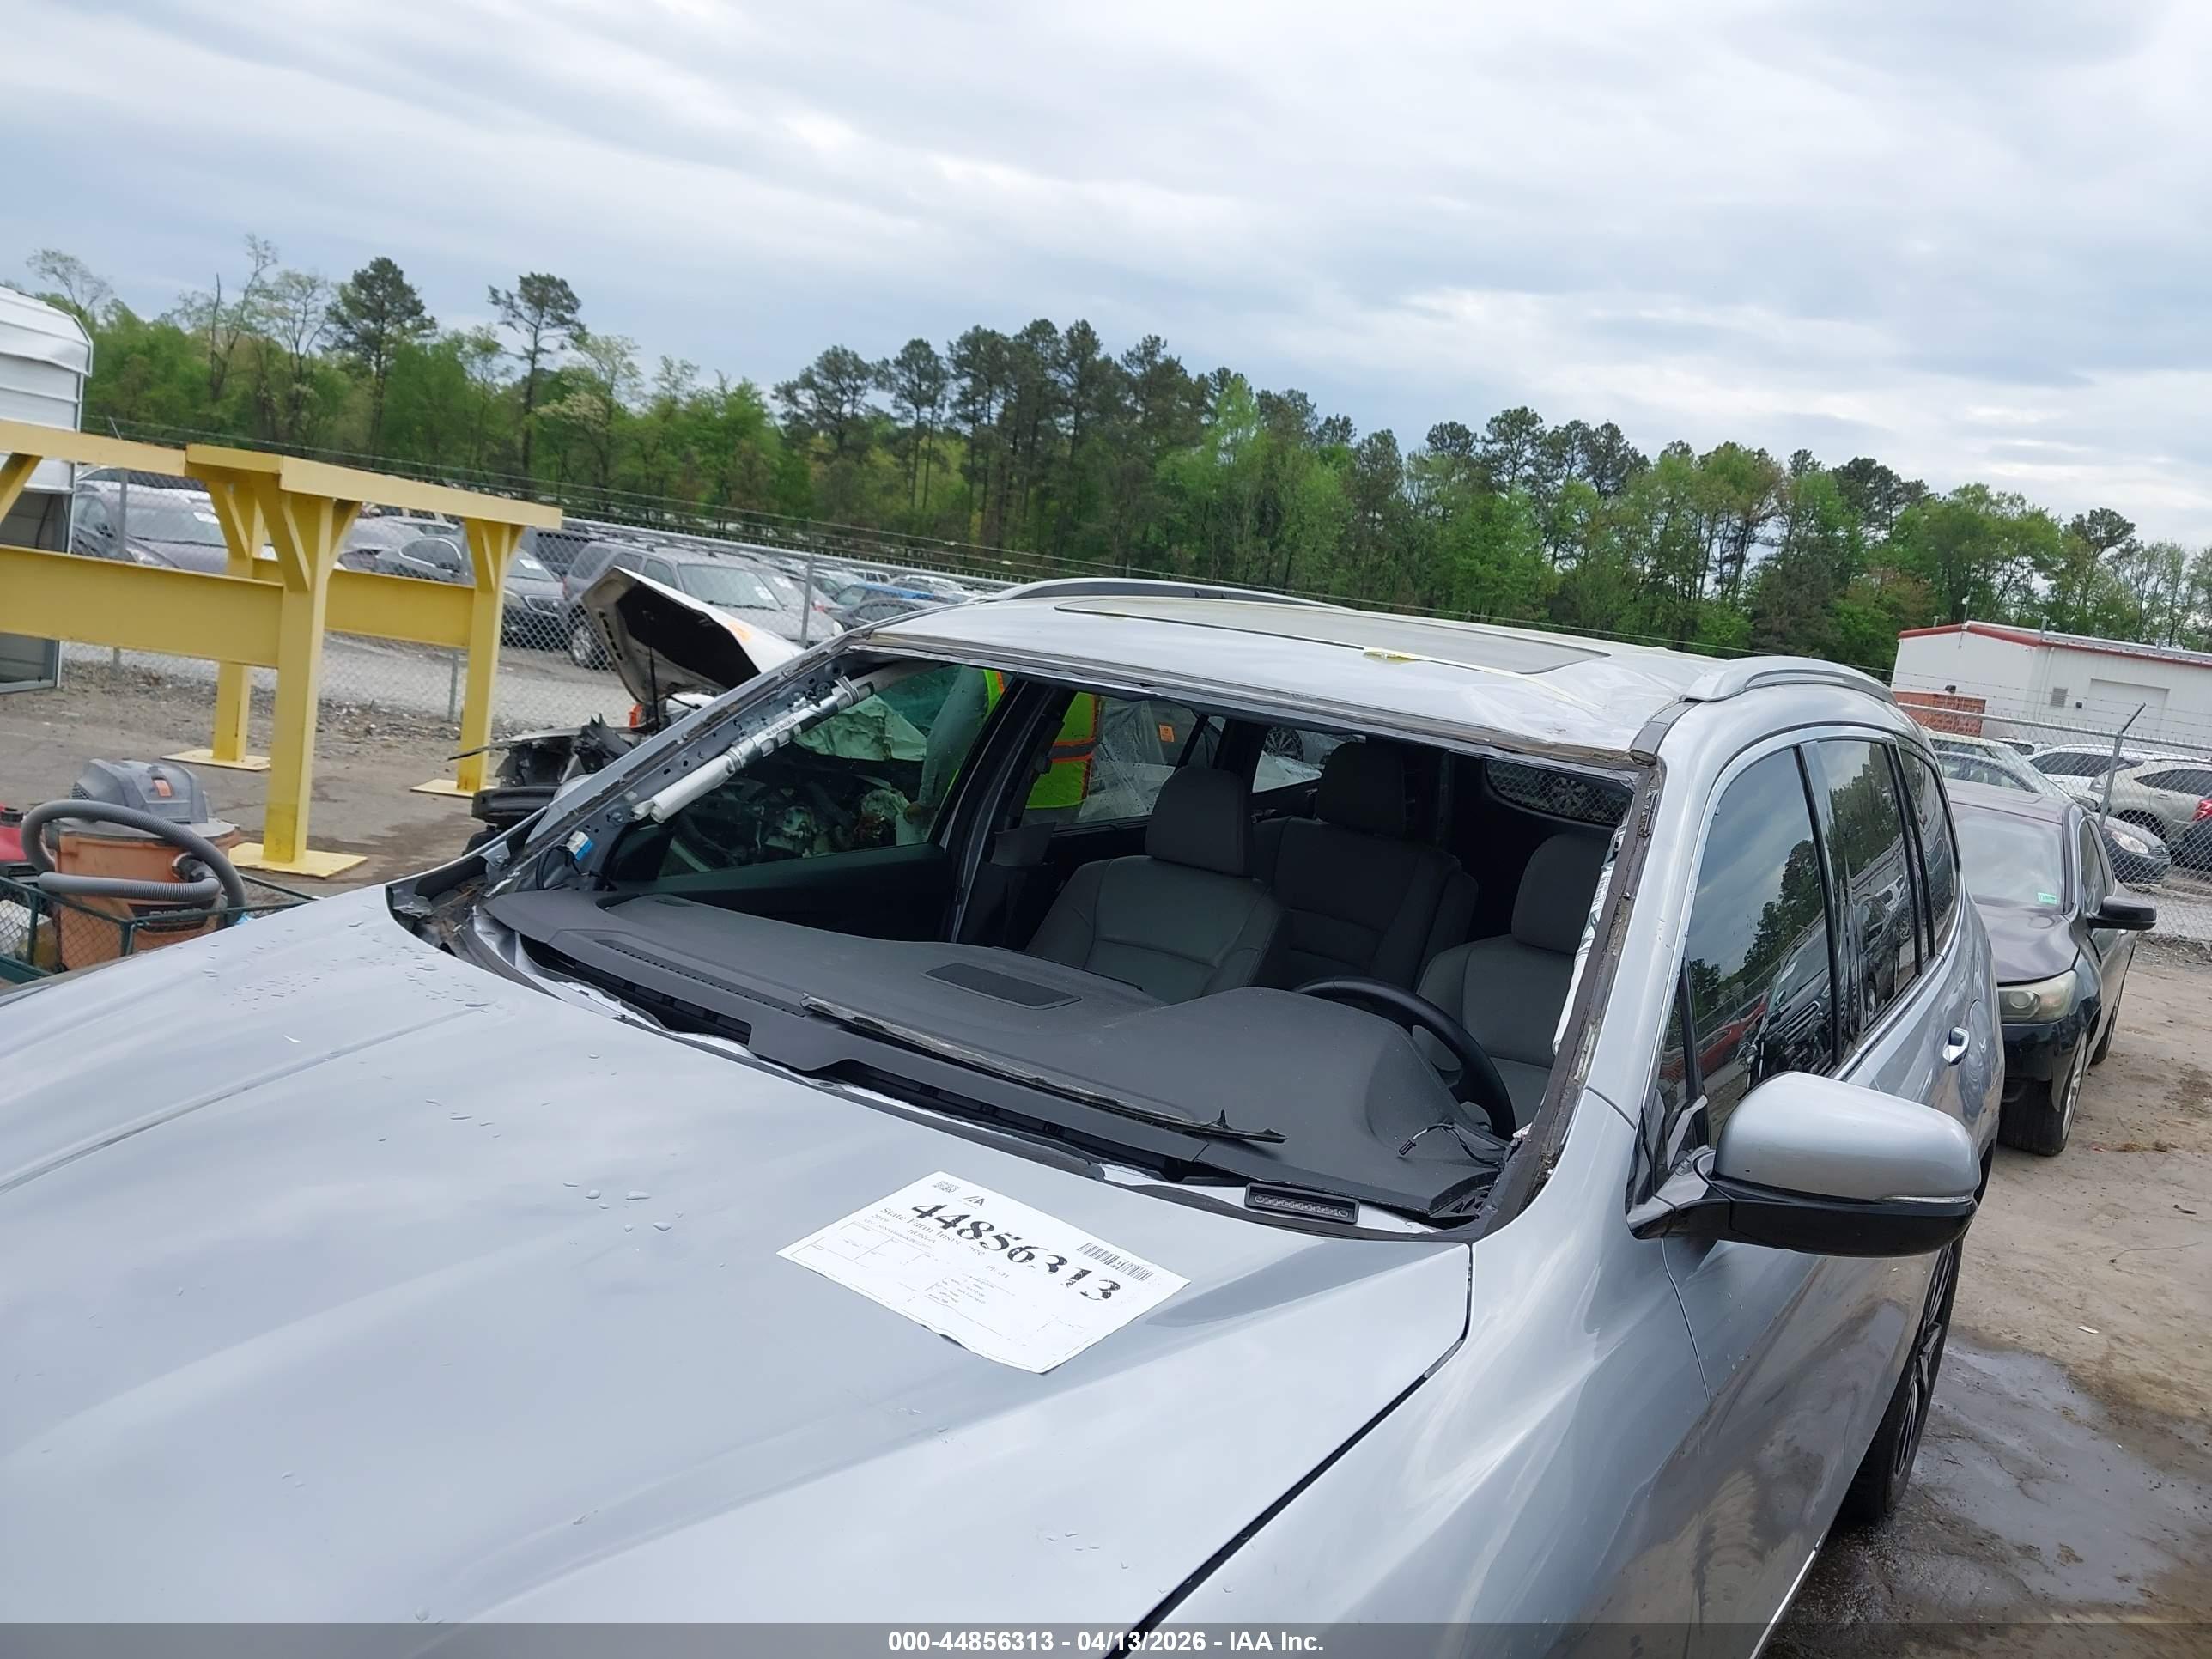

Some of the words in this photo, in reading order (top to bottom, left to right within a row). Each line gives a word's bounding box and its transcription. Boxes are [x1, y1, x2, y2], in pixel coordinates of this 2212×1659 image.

[880, 1207, 907, 1222] State
[907, 1218, 935, 1233] Farm
[936, 1231, 986, 1256] Insurnce
[911, 1204, 1121, 1301] 44856313
